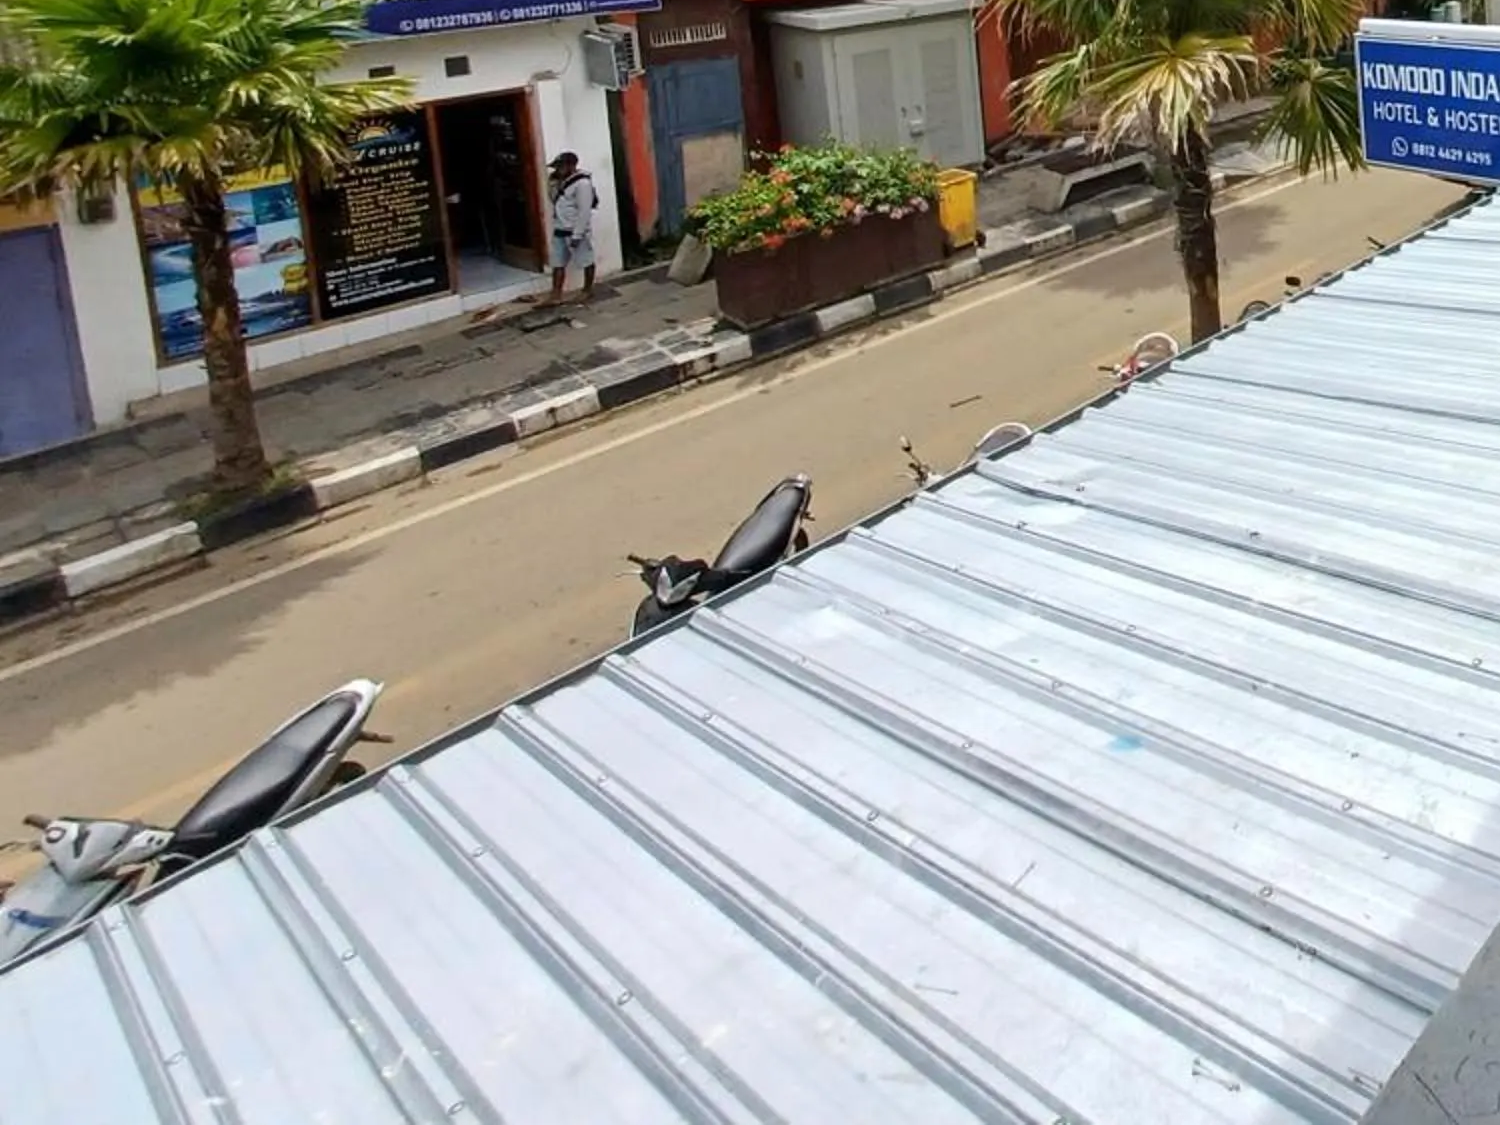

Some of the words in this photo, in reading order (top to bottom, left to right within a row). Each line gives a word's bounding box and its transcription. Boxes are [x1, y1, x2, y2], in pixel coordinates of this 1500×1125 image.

[1362, 62, 1446, 96] KOMODO
[1373, 101, 1422, 125] HOTEL
[1427, 107, 1440, 128] &
[367, 141, 421, 159] CRUISE
[1412, 142, 1436, 158] 0812
